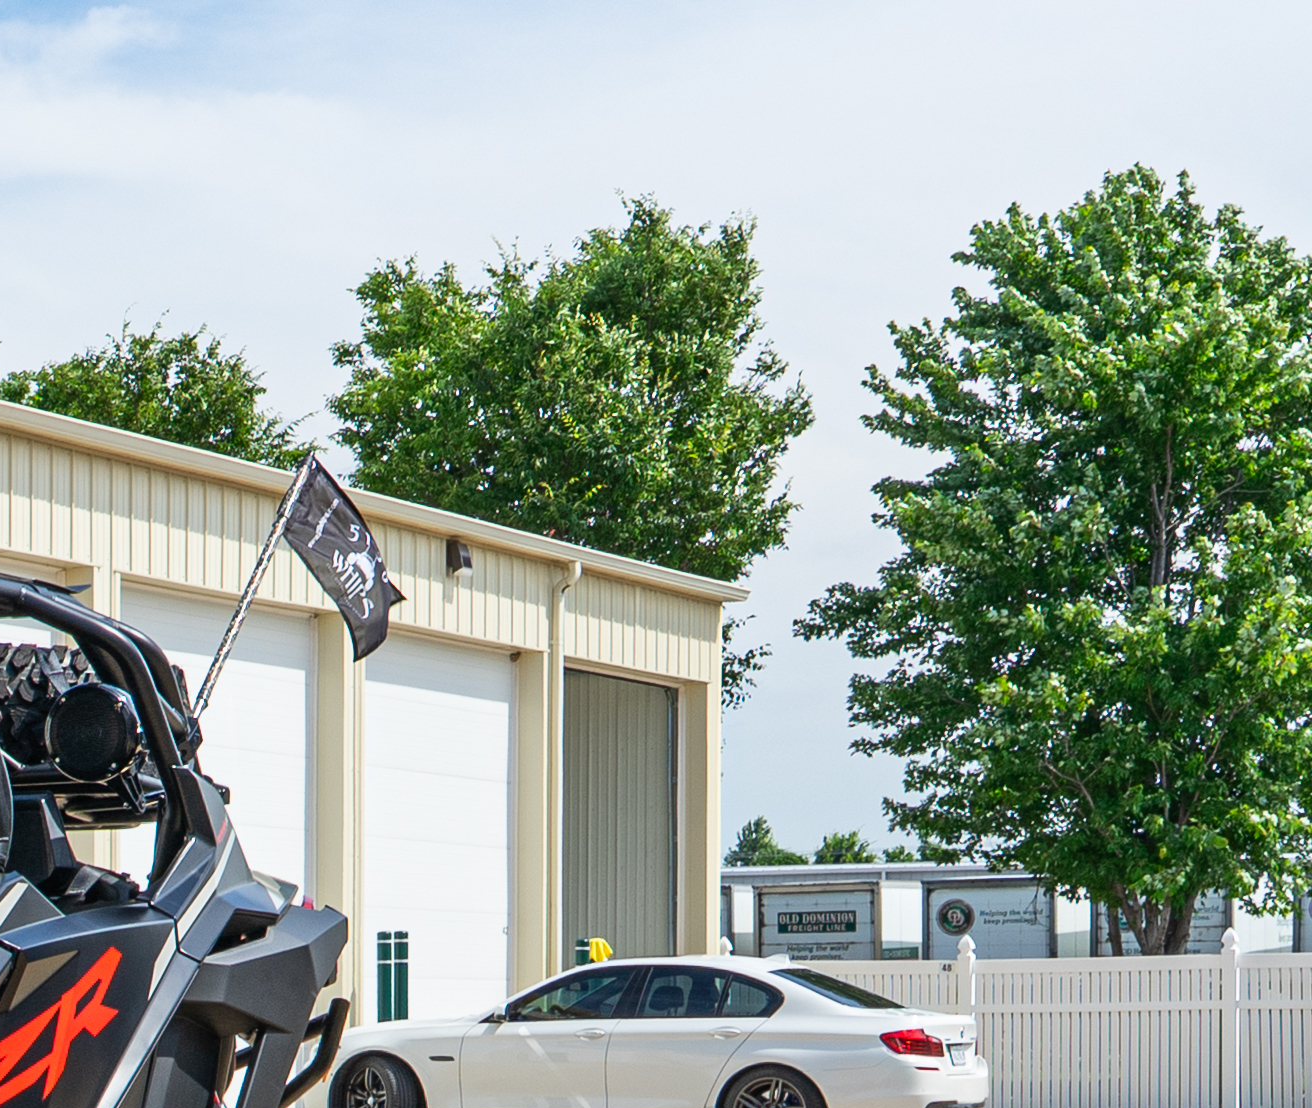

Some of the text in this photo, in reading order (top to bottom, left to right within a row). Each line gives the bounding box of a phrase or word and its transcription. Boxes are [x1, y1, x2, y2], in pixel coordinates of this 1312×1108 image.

[332, 549, 375, 619] WHIPS
[779, 912, 855, 924] OLD DOMINION
